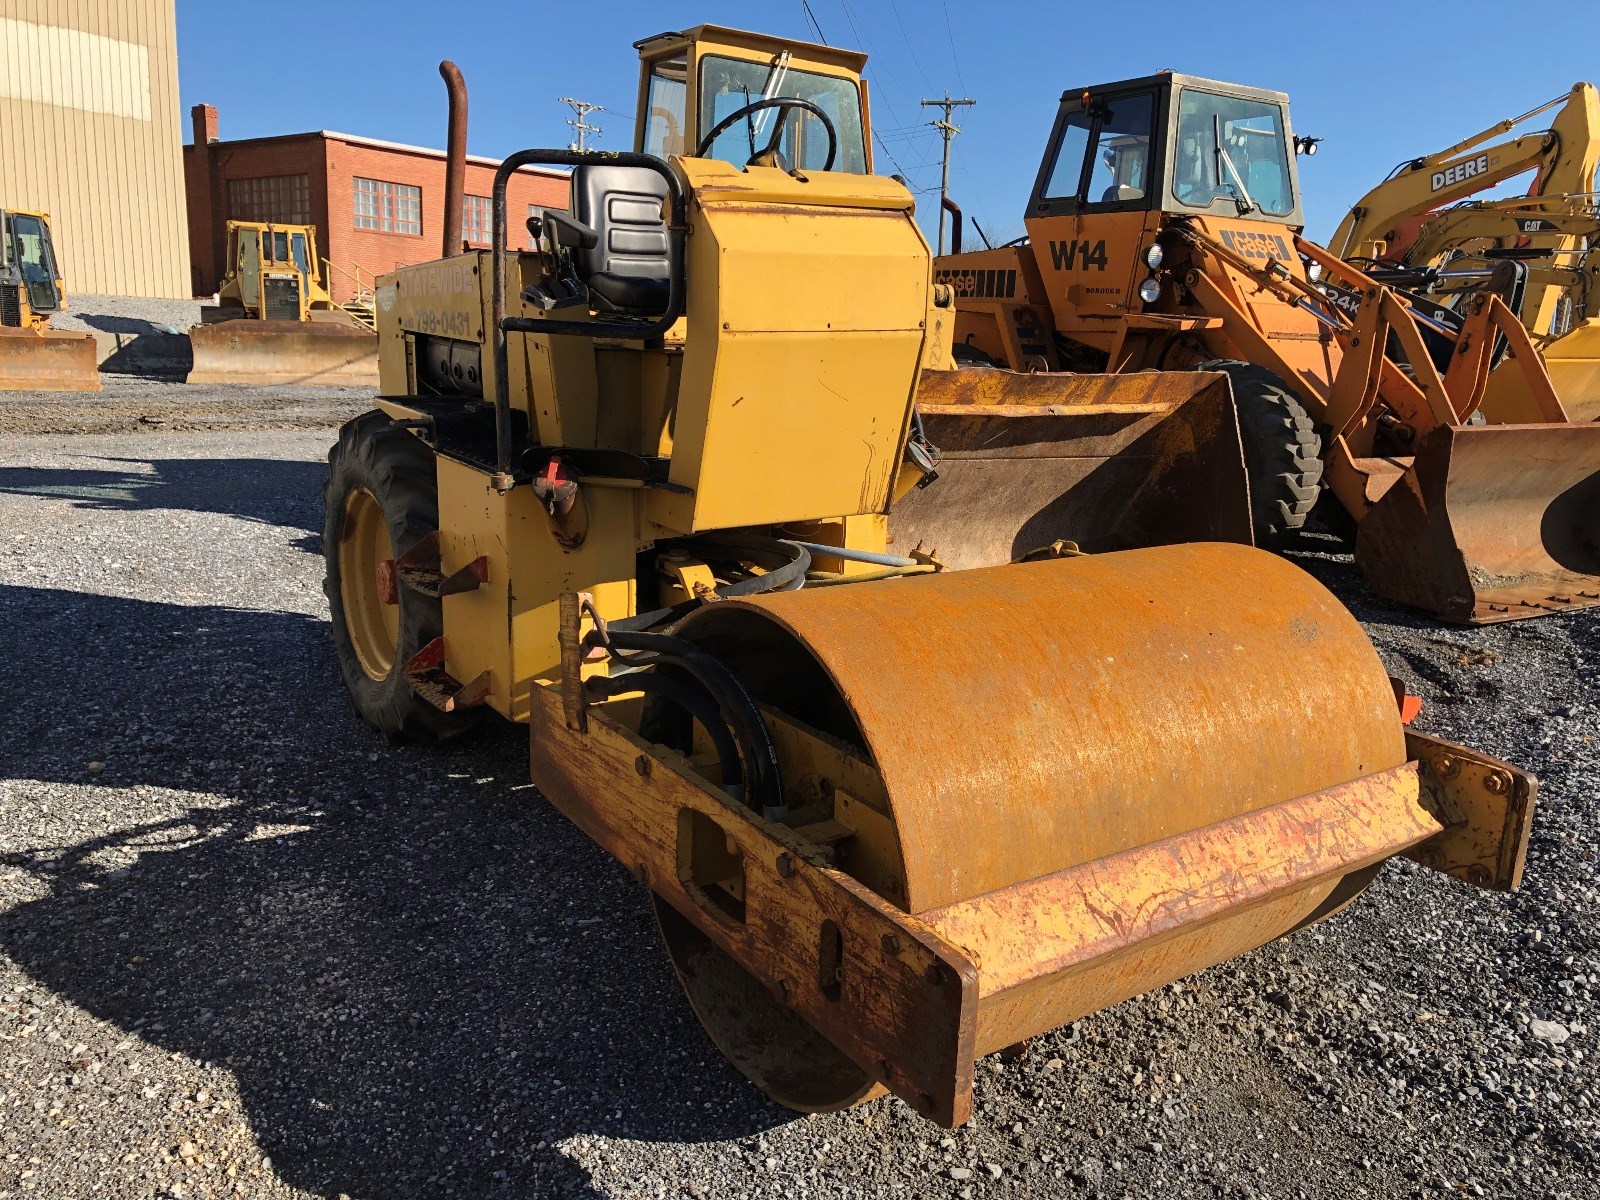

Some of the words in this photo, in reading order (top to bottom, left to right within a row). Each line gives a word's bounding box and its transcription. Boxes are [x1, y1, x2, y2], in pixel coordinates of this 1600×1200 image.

[1432, 155, 1487, 191] DEERE
[1524, 220, 1542, 232] CAT
[1049, 240, 1108, 271] W14
[1086, 287, 1121, 295] BOROUGH
[415, 309, 470, 337] 798-0431
